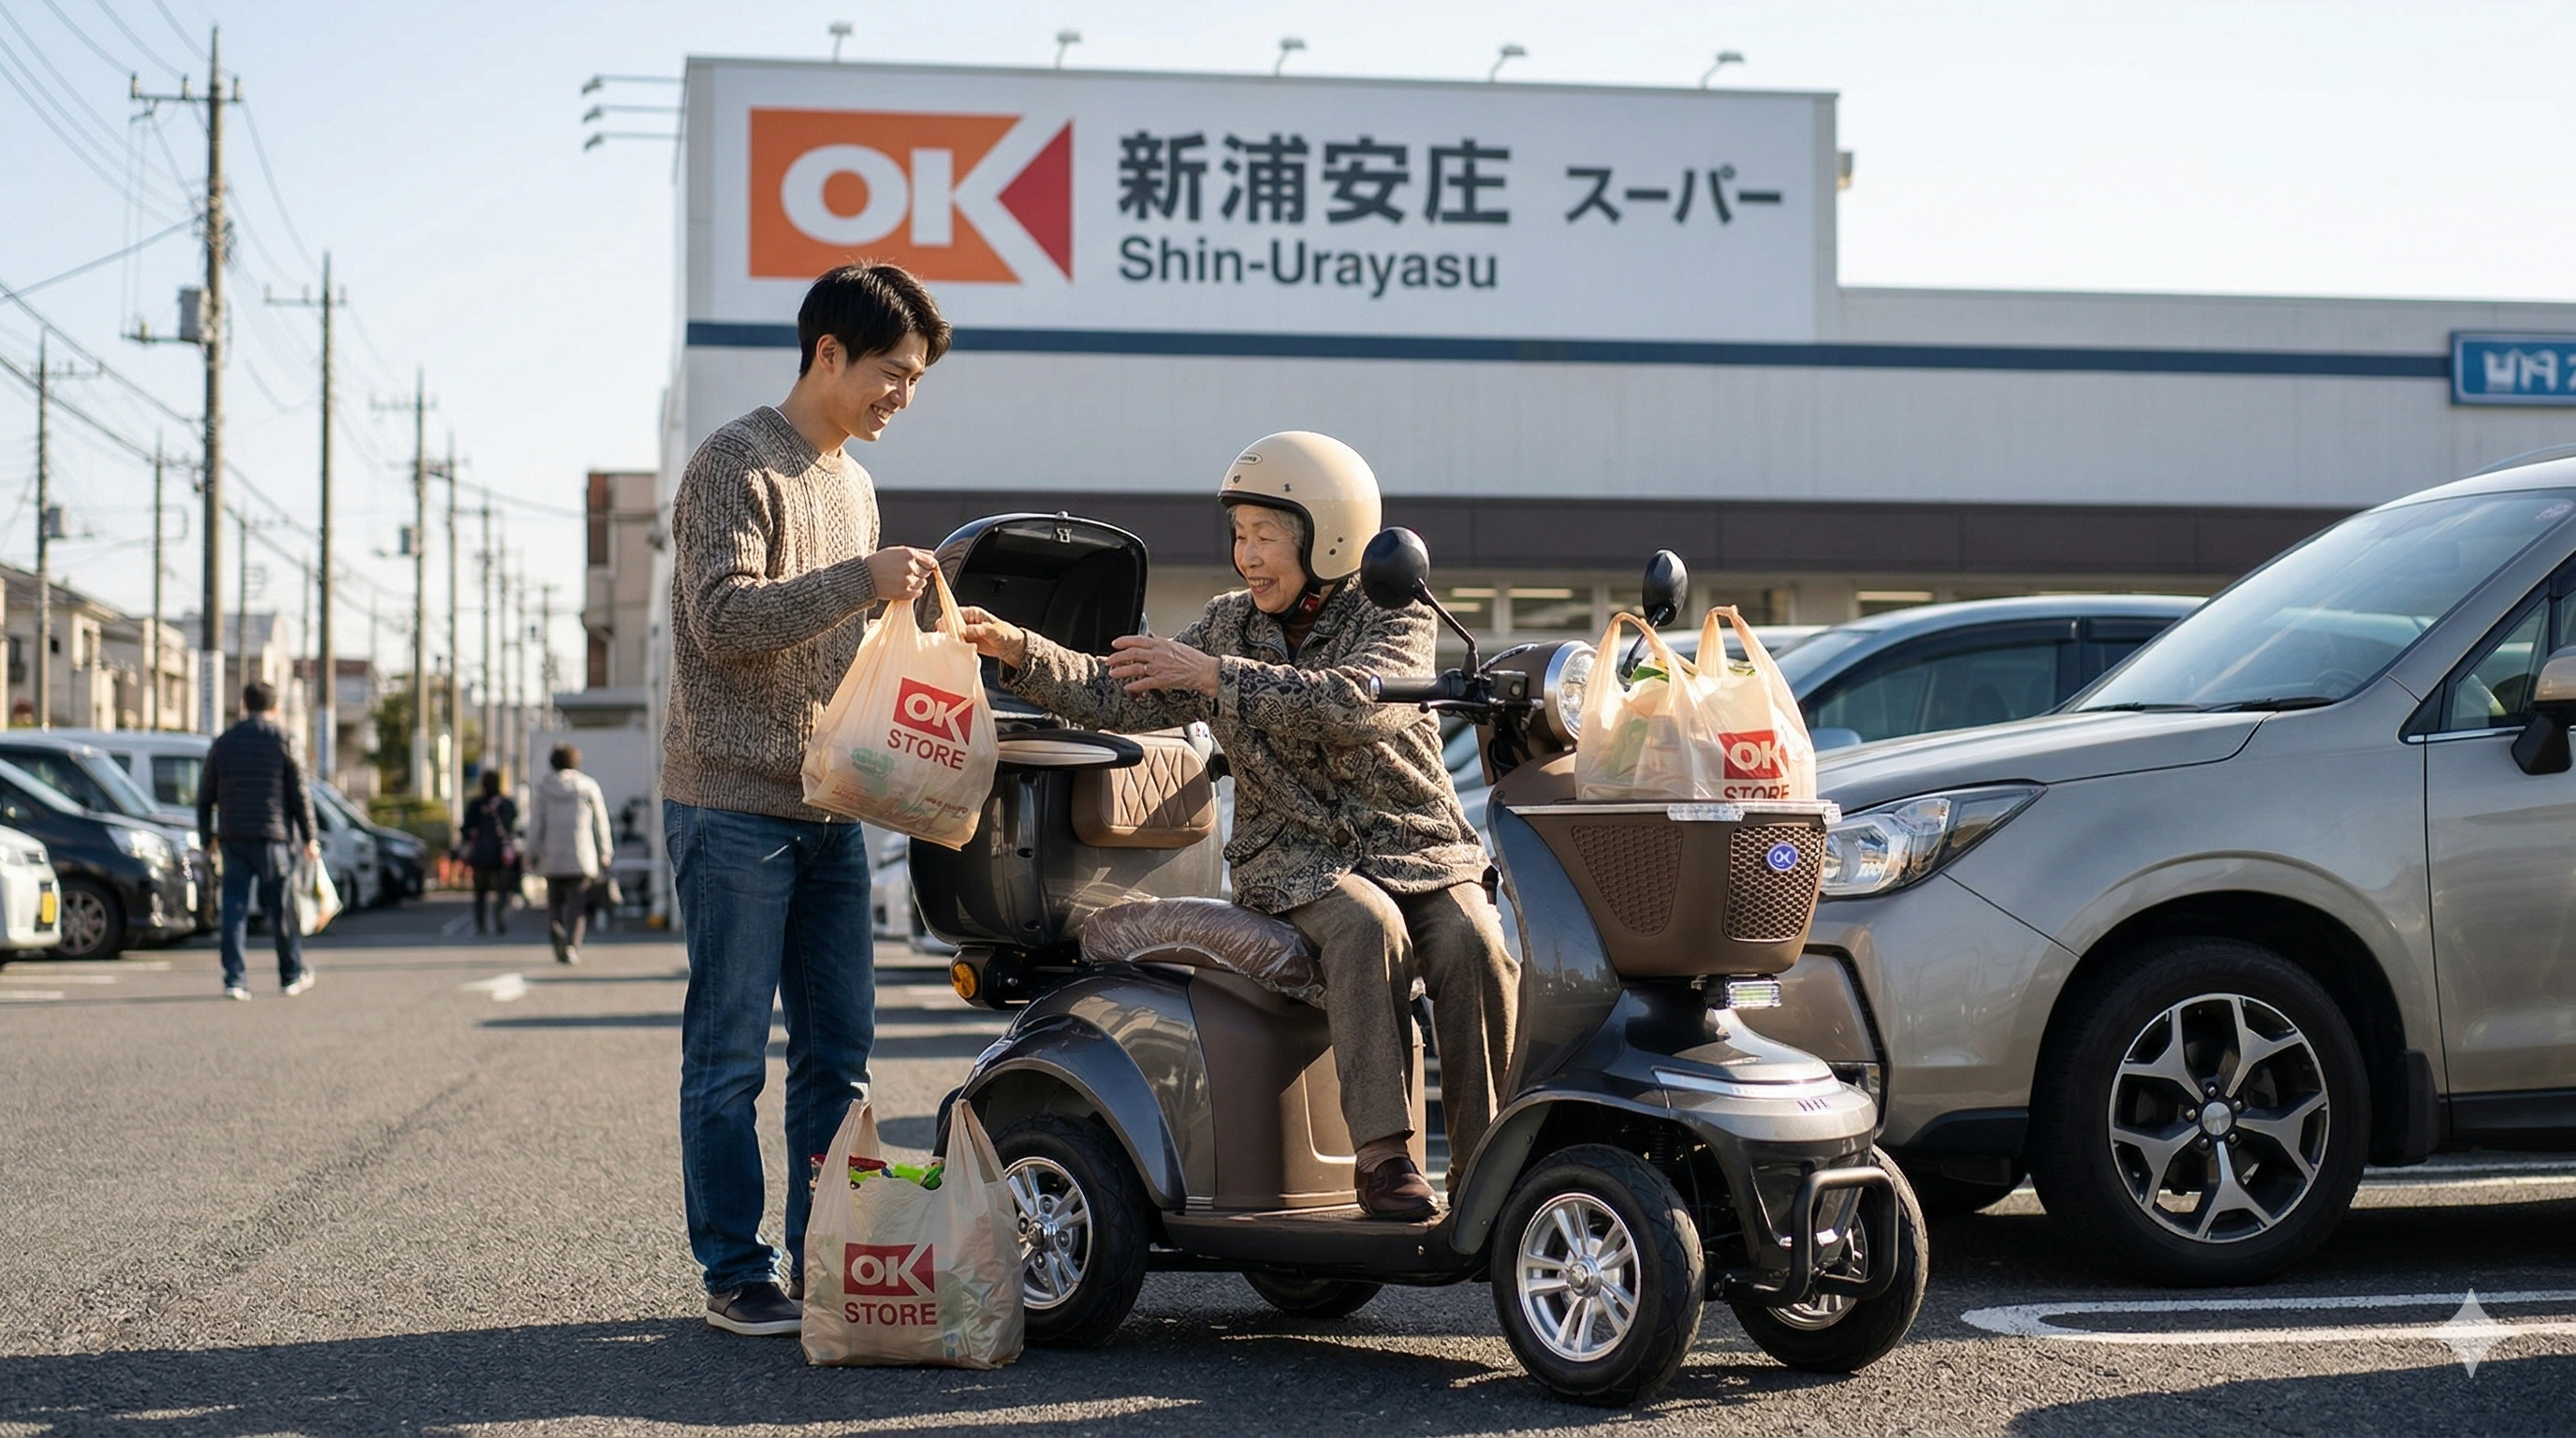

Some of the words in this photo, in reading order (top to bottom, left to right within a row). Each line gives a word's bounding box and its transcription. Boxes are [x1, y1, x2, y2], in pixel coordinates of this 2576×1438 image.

[779, 111, 1072, 286] OK
[1118, 131, 1510, 224] 新浦安庄
[1564, 164, 1782, 224] スーパー
[1119, 236, 1498, 298] Shin-Urayasu
[904, 692, 974, 747] OK
[886, 728, 966, 770] STORE
[1730, 729, 1789, 777] OK
[851, 1243, 934, 1297] OK
[844, 1301, 937, 1326] STORE
